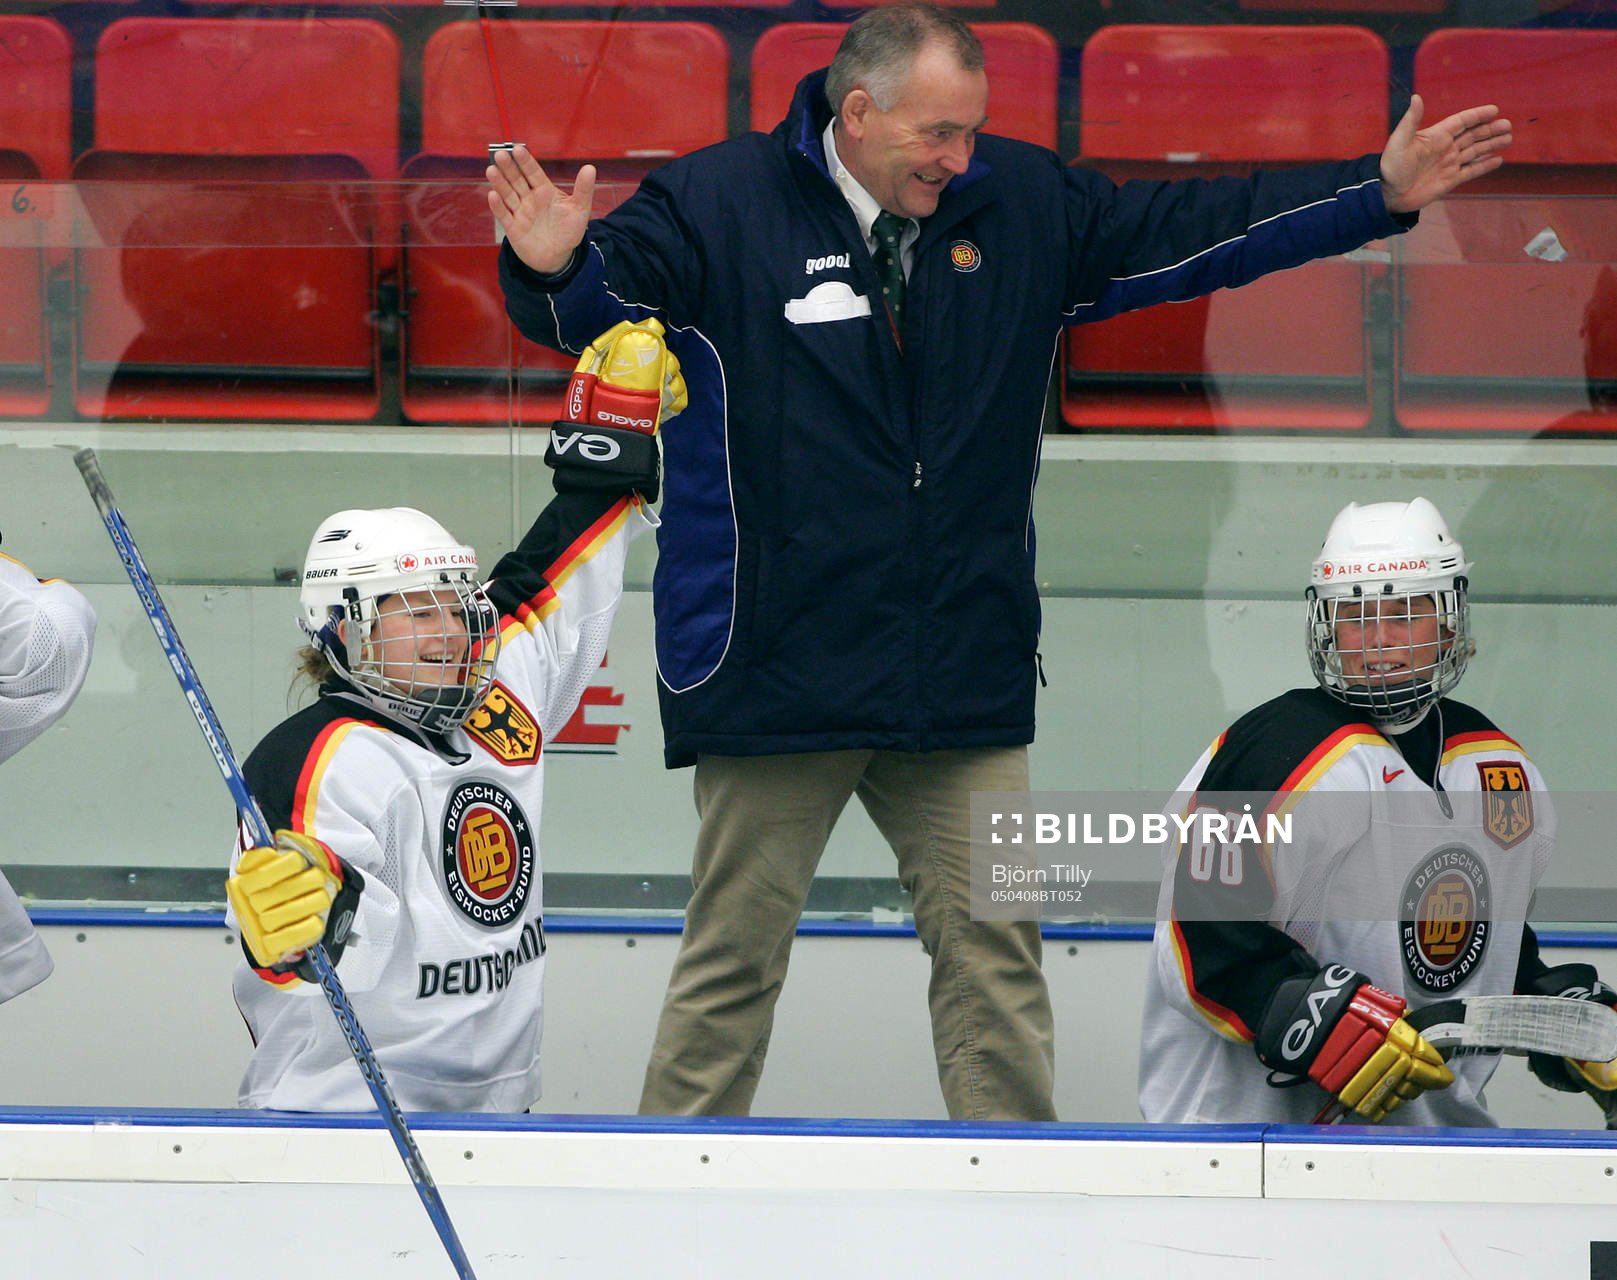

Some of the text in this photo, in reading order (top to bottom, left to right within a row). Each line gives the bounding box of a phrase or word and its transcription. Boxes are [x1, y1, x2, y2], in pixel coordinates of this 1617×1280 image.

[572, 379, 585, 413] CP94
[425, 556, 447, 566] AIR
[1338, 559, 1427, 575] AIR CANADA
[447, 786, 512, 832] DEUTSCHER
[1415, 853, 1484, 889] DEUTSCHER
